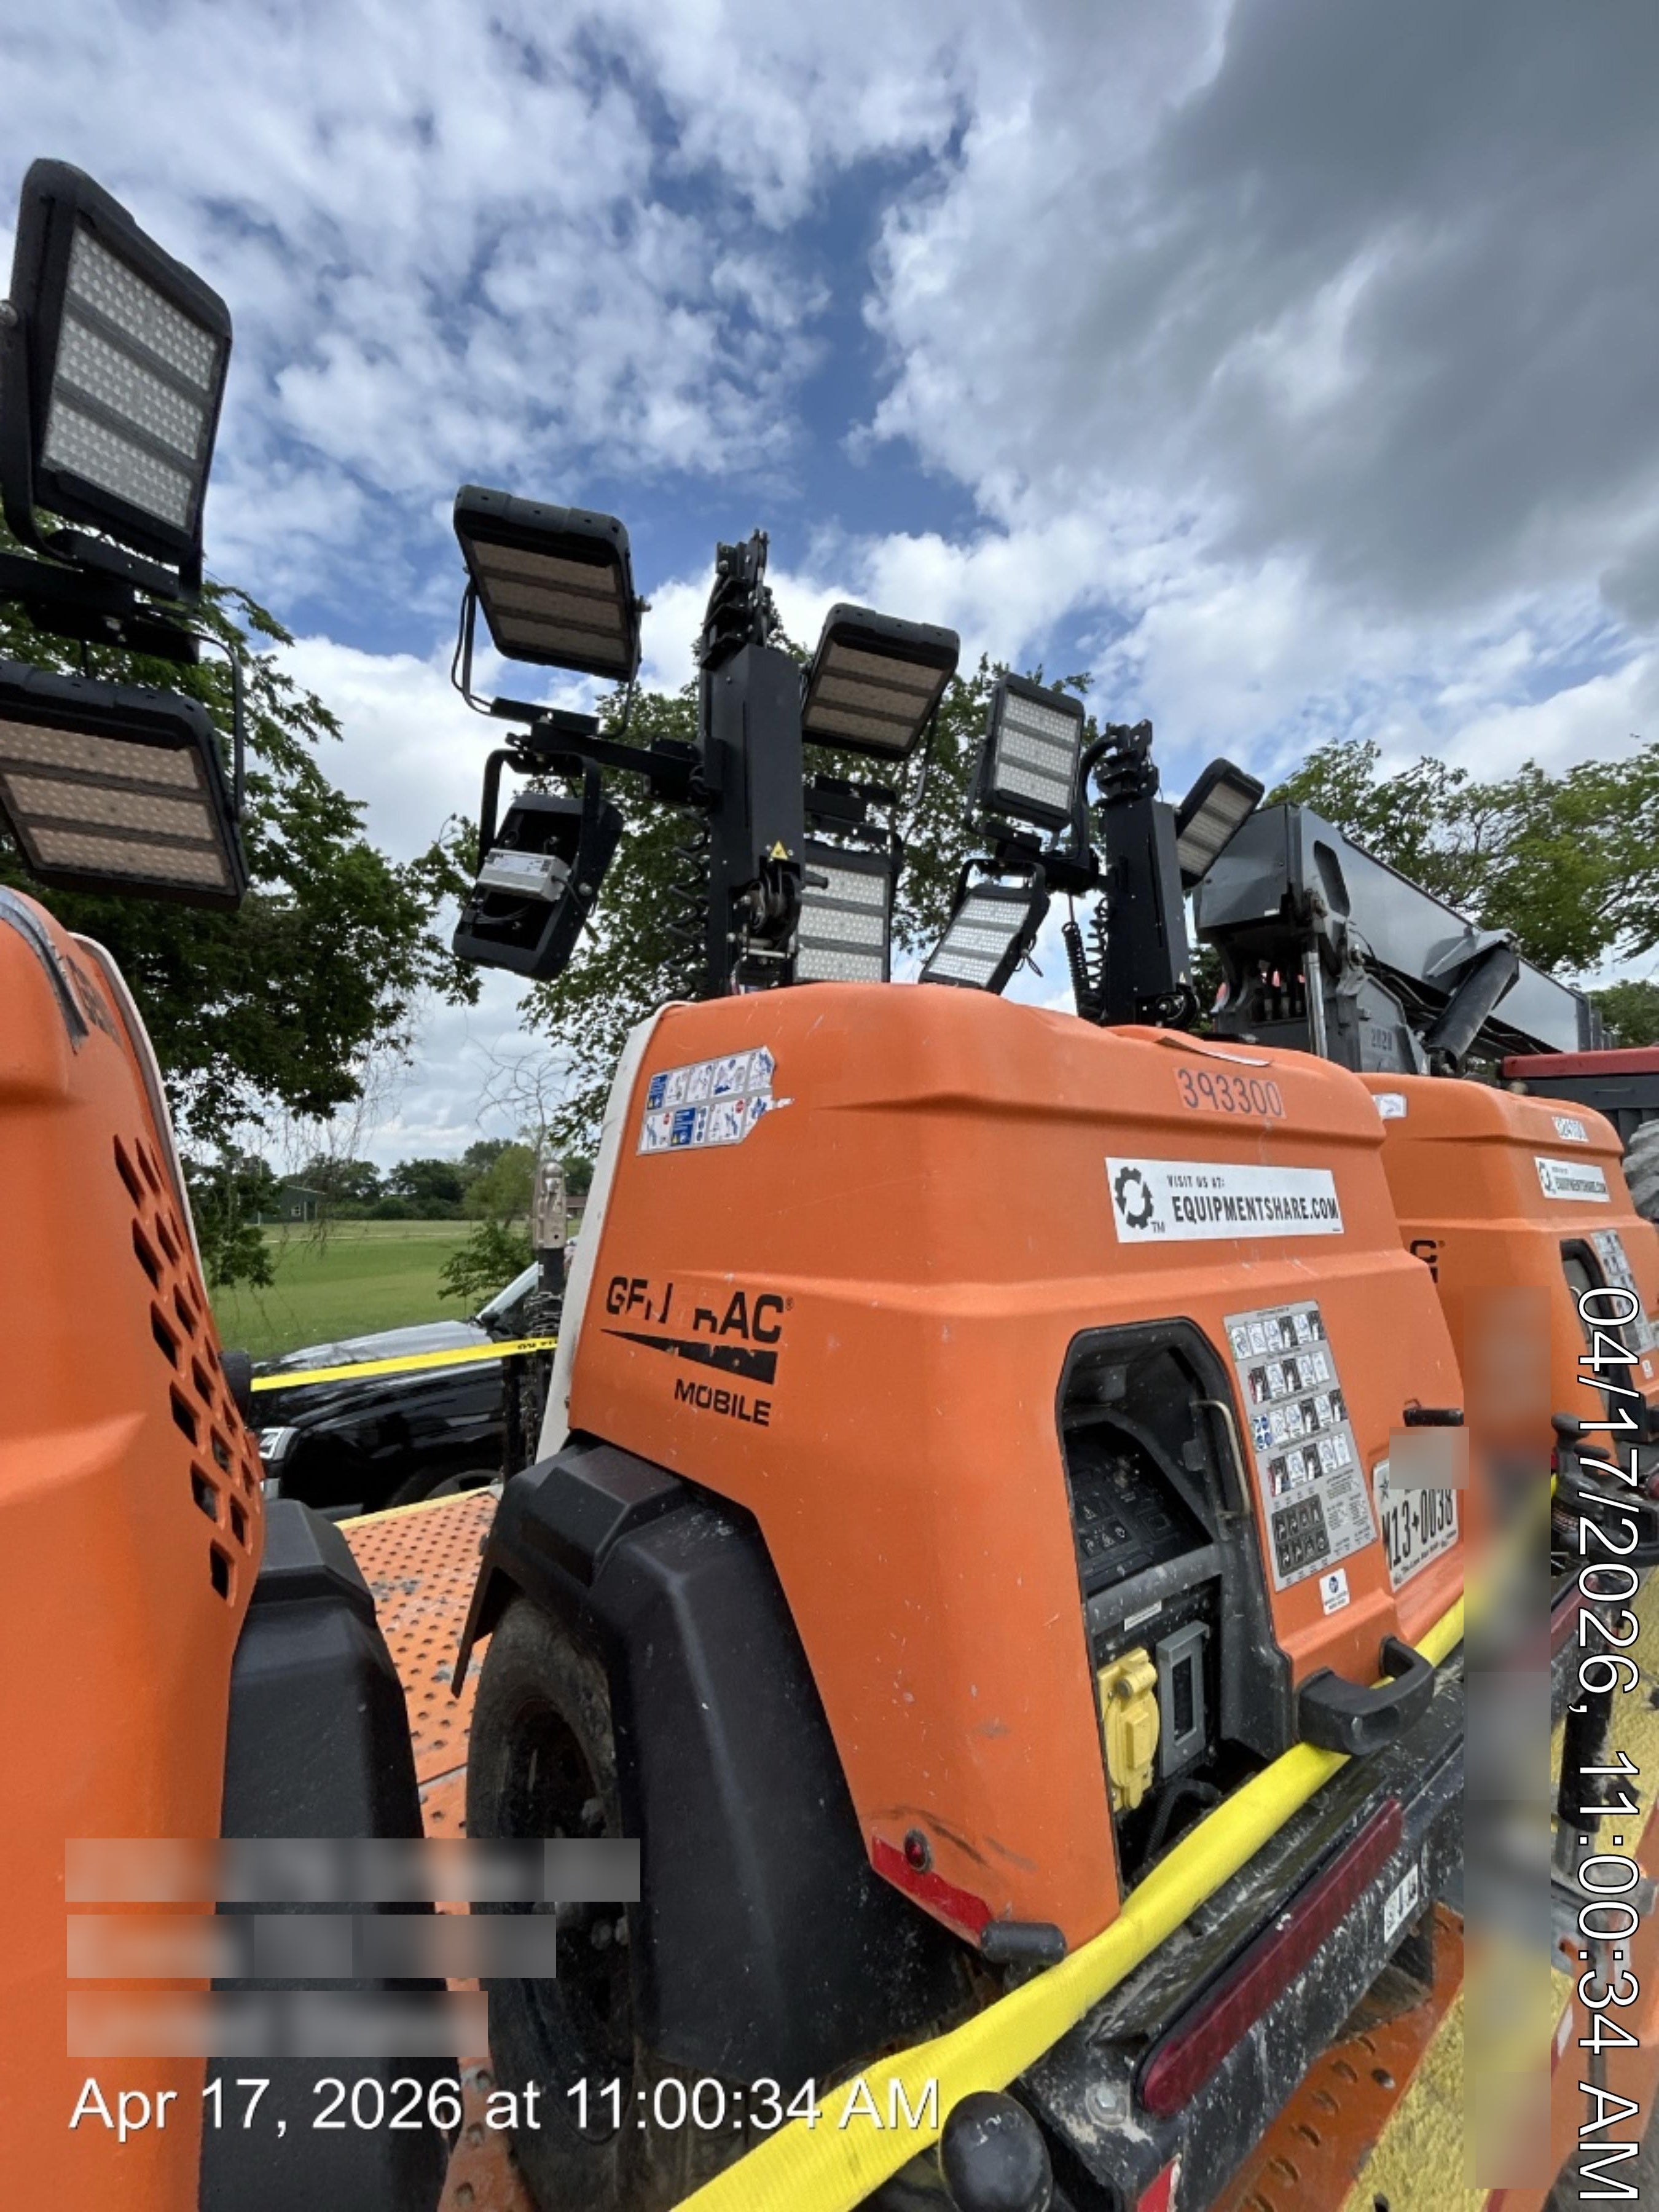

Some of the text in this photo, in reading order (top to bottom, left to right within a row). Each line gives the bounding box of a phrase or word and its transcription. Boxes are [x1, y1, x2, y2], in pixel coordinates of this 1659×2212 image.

[1178, 1069, 1282, 1116] 393300
[1167, 1175, 1226, 1189] VISIT US AT:
[1172, 1196, 1339, 1224] EQUIPMENTSHARE.COM
[675, 1379, 772, 1427] MOBILE
